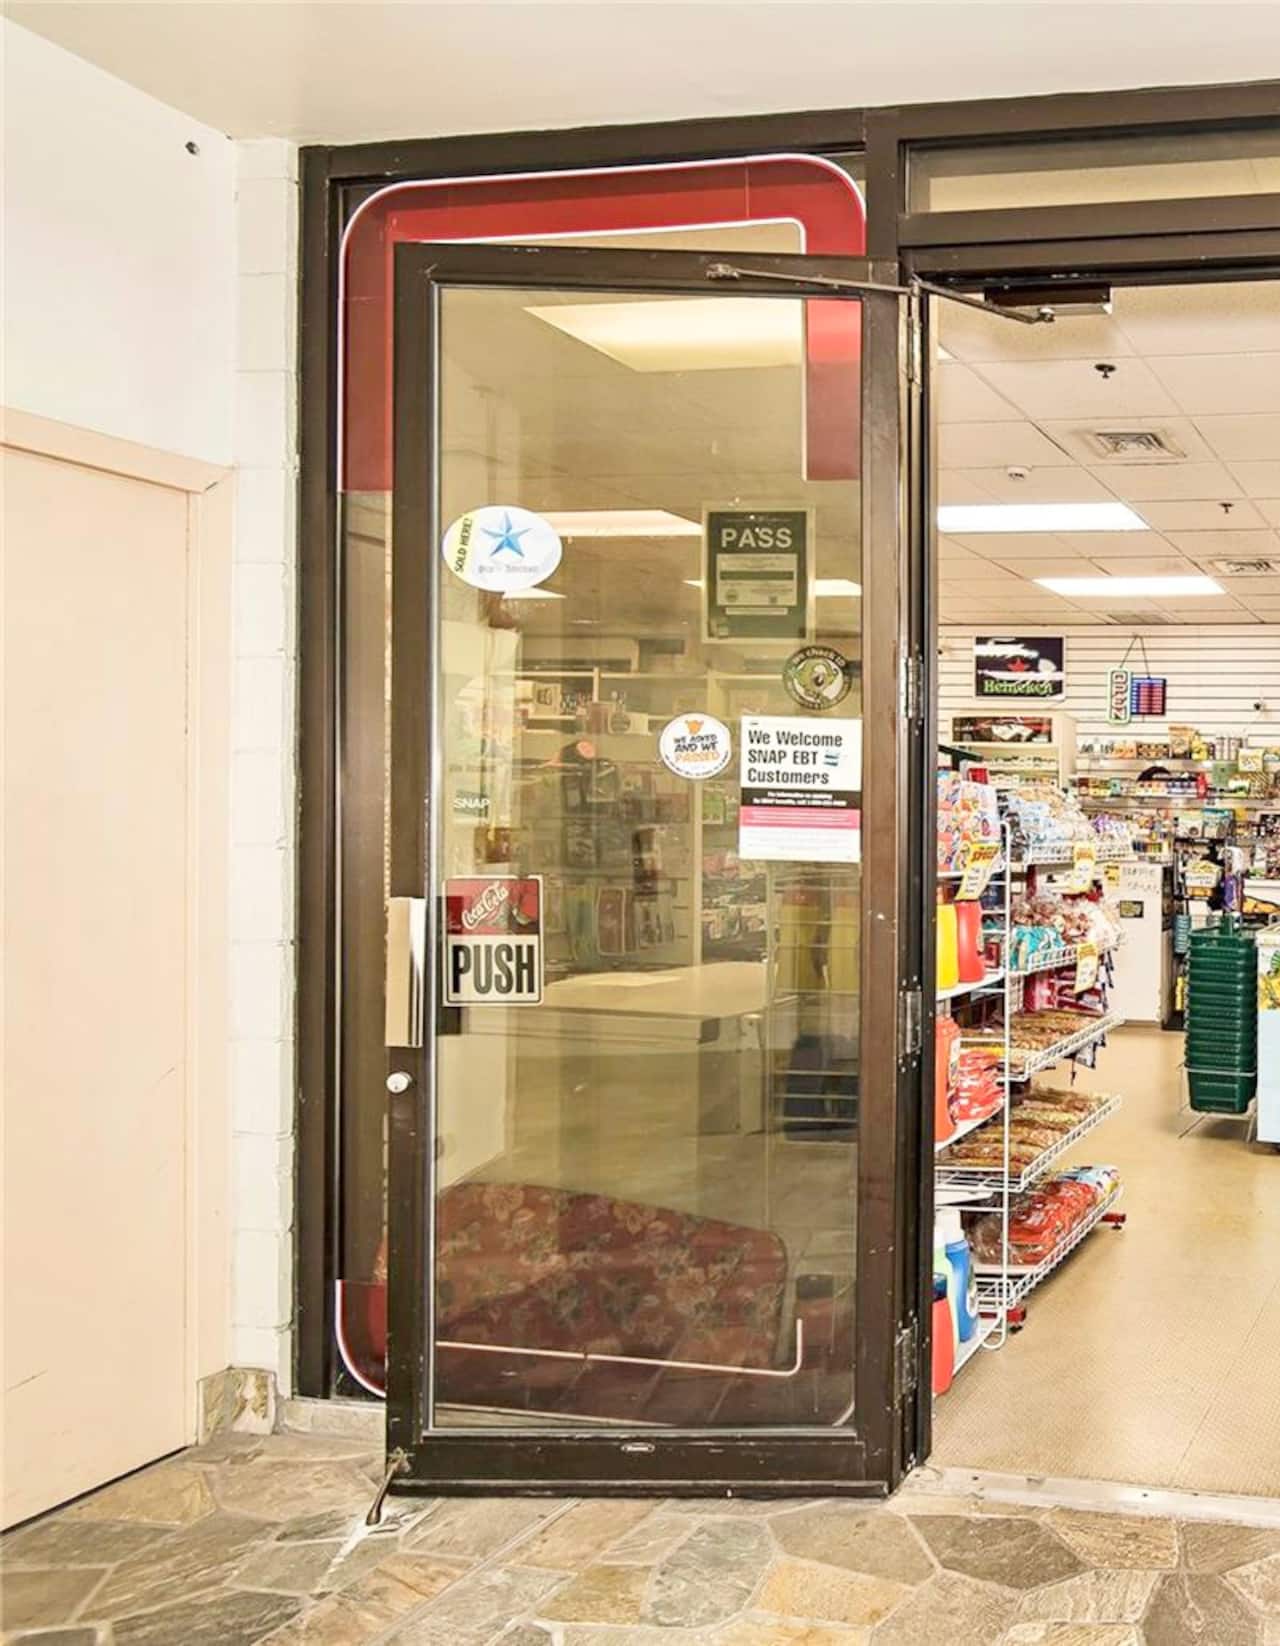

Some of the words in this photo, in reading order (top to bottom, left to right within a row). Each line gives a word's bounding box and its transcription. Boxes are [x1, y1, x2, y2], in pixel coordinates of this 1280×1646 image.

[721, 526, 793, 549] PASS
[454, 547, 470, 573] SOLD
[748, 730, 771, 745] We
[776, 731, 843, 748] Welcome
[747, 749, 787, 765] SNAP
[792, 751, 819, 766] EBT
[747, 768, 830, 785] Customers
[452, 943, 536, 995] PUSH
